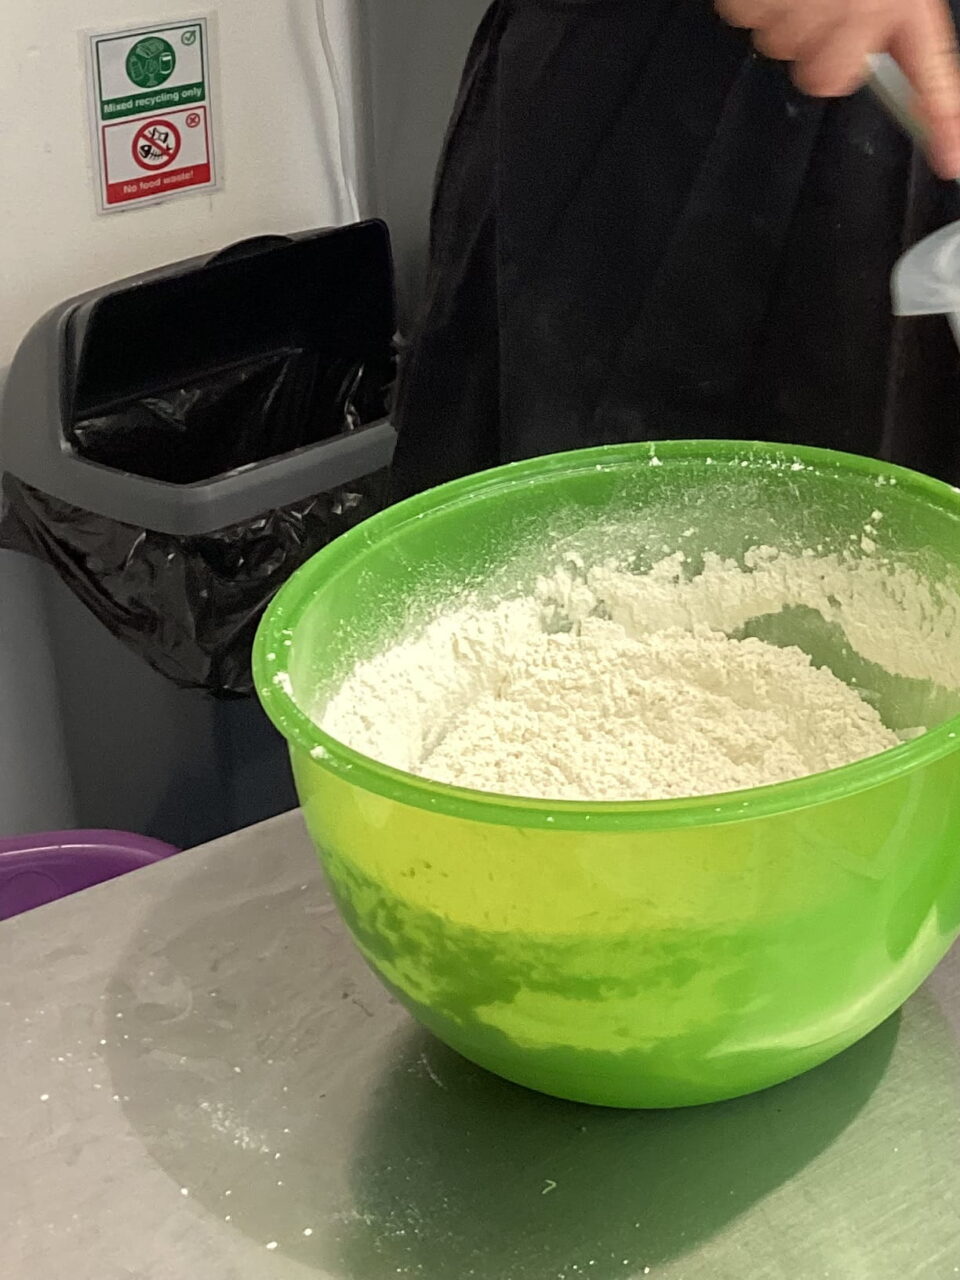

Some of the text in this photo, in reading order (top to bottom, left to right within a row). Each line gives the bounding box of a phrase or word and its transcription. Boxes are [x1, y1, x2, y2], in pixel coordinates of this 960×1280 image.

[103, 87, 202, 113] Mixed recycling only
[123, 170, 194, 193] No food waste!
